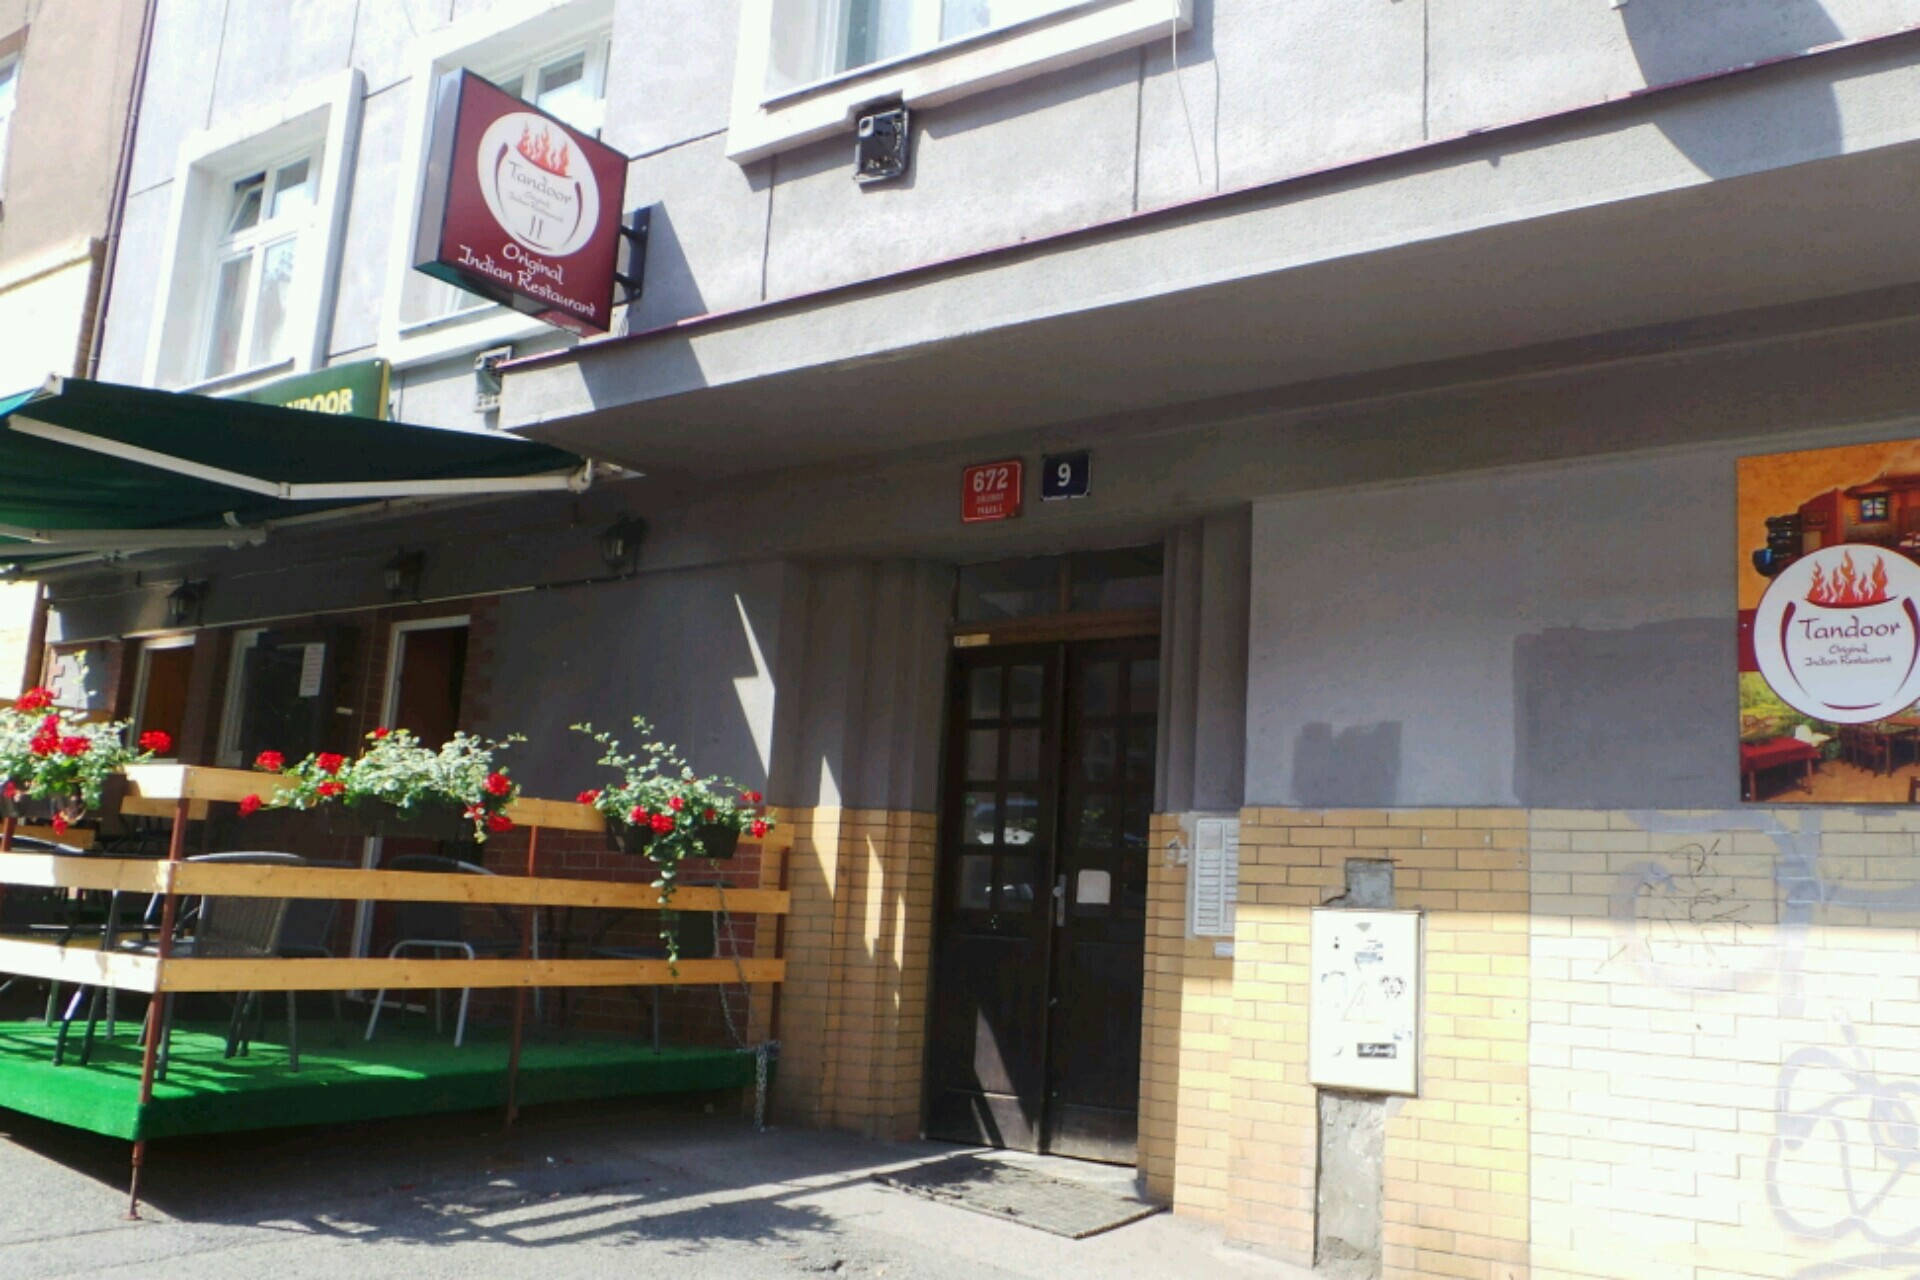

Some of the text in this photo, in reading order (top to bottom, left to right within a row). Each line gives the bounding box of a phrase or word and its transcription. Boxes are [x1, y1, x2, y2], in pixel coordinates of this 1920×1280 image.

[509, 160, 572, 203] Tandoor
[502, 242, 564, 285] Original
[457, 244, 596, 317] Indian Restaurant
[973, 468, 1009, 492] 672
[1057, 463, 1071, 487] 9
[1798, 615, 1901, 640] Tandoor
[1805, 657, 1838, 667] Indian
[1828, 644, 1869, 658] Original
